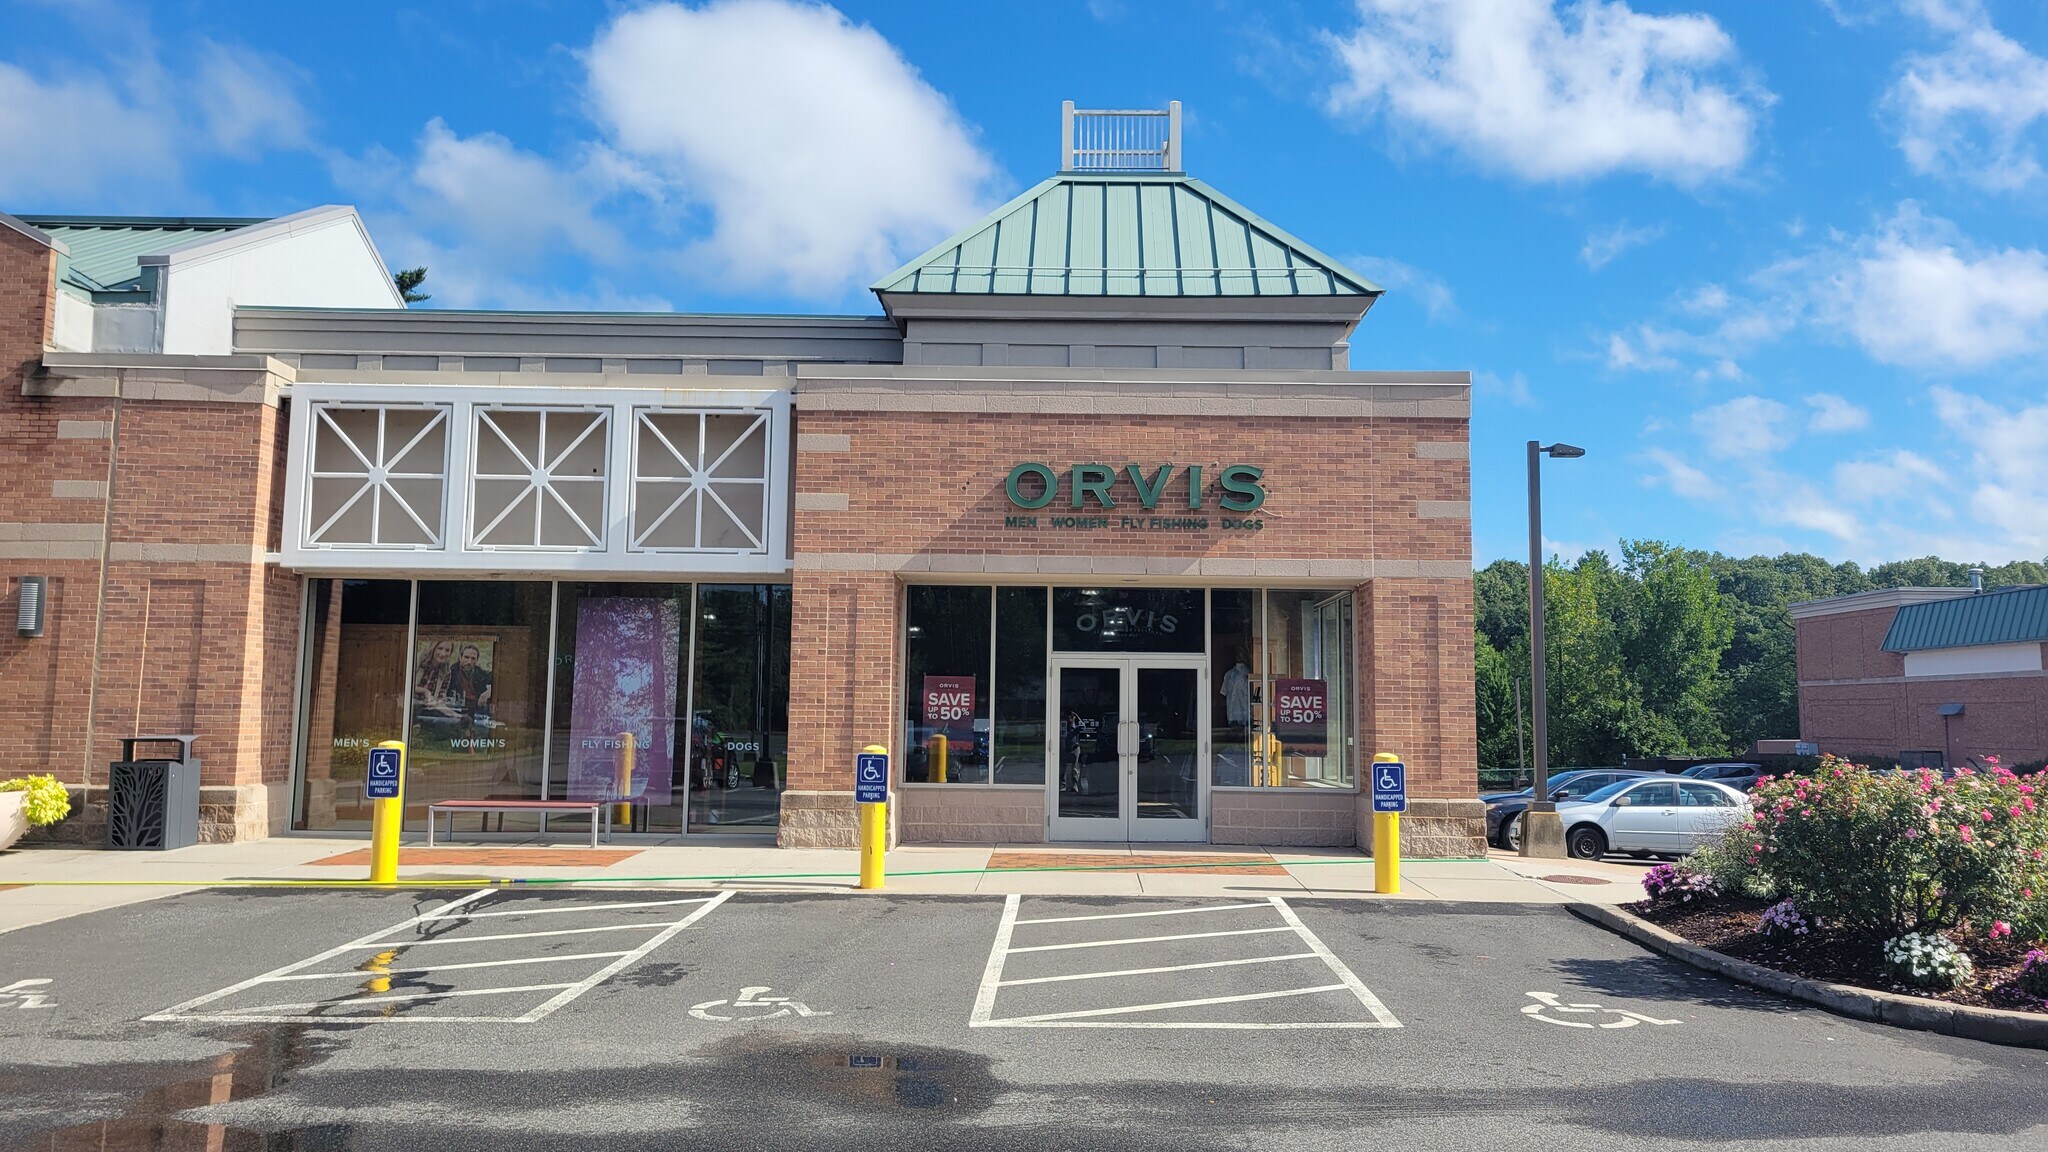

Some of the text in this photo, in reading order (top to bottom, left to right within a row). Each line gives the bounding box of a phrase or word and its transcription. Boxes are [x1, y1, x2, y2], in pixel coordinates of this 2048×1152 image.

[1005, 462, 1266, 511] ORVIS
[1005, 516, 1264, 530] MEN WOMEN FLY FISHING DOGS
[1076, 607, 1178, 633] ORVIS
[928, 693, 970, 706] SAVE
[1280, 696, 1322, 708] SAVE
[940, 706, 970, 720] 50%
[1292, 710, 1322, 723] 50%
[333, 738, 370, 747] MEN'S
[450, 738, 506, 748] WOMEN'S
[581, 740, 650, 749] FLY FISHING
[728, 742, 760, 750] DOGS
